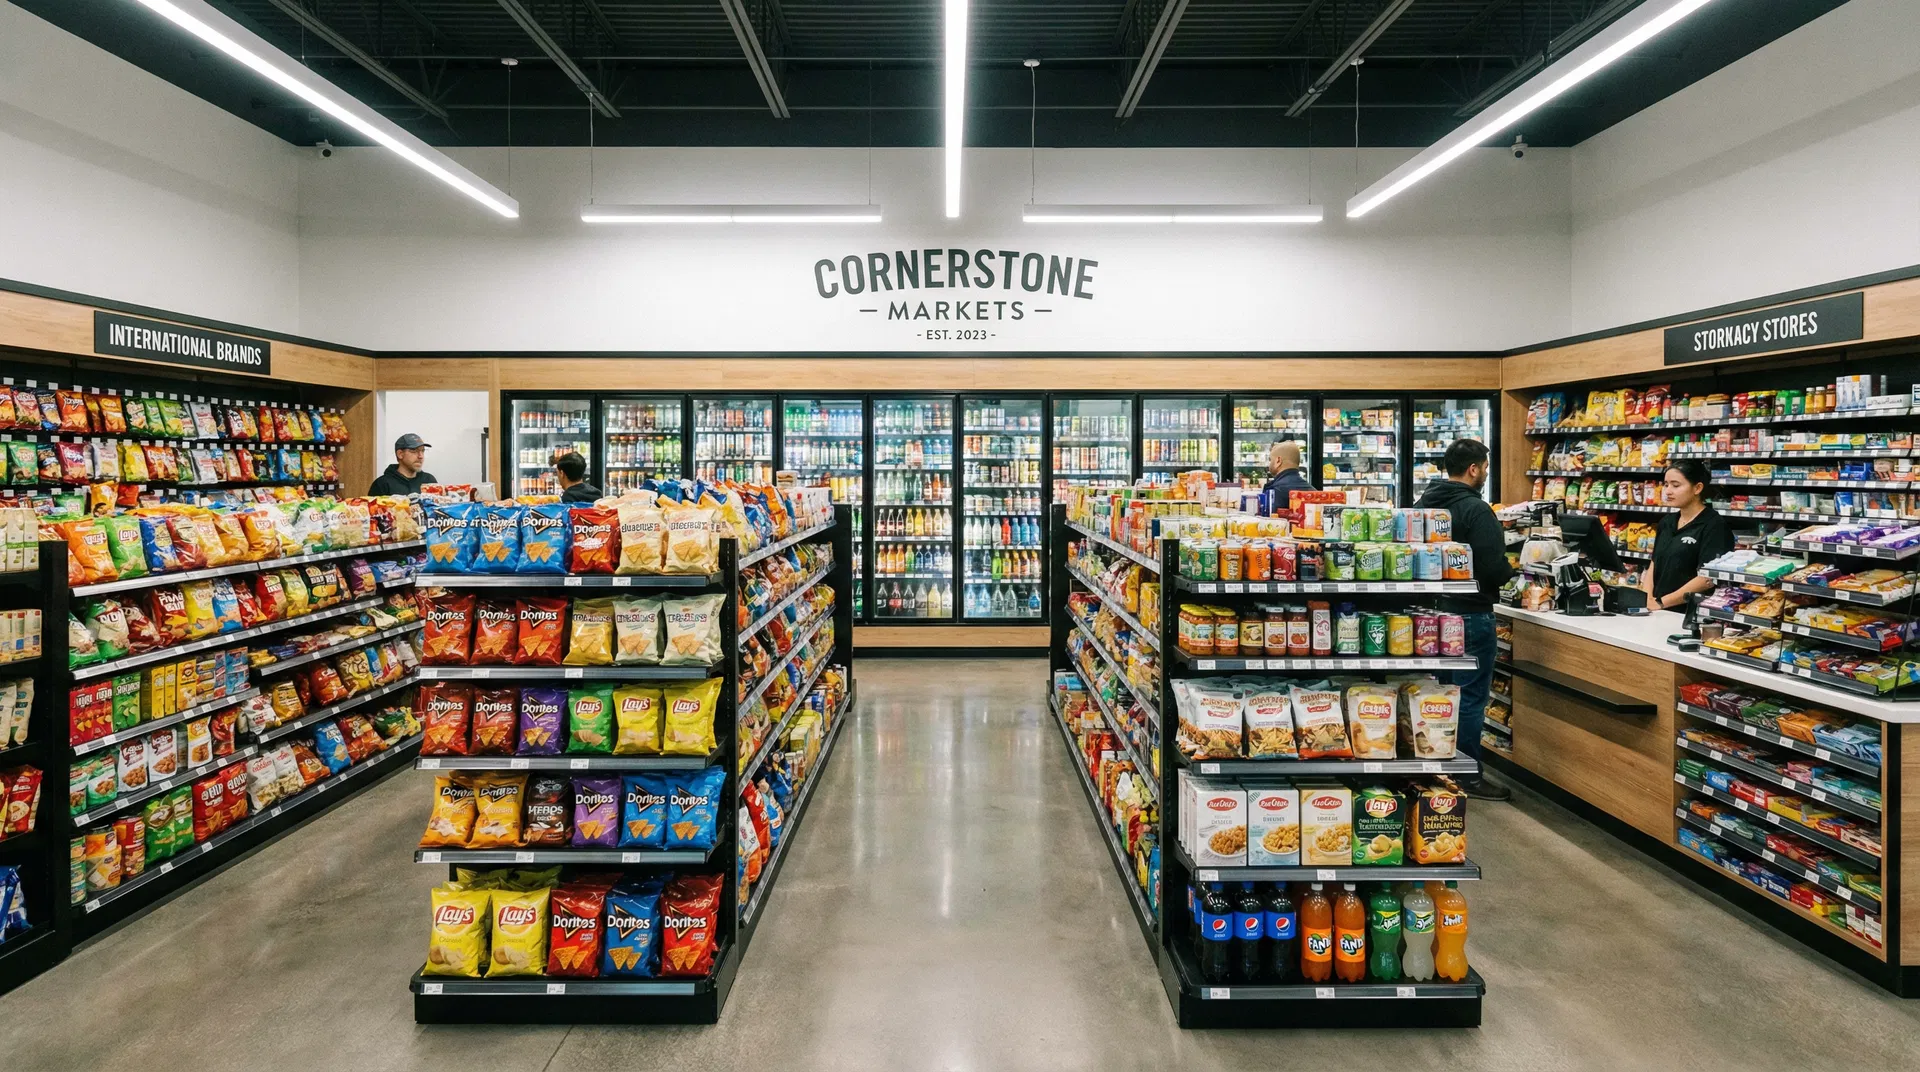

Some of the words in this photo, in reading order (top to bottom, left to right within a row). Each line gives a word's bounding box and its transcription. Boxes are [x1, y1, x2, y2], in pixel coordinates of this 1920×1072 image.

[814, 249, 1098, 300] CORNERSTONE
[888, 301, 1024, 320] MARKETS
[926, 329, 952, 340] EST.
[956, 329, 987, 340] 2023
[1694, 321, 1759, 352] STORKACY
[1762, 311, 1818, 342] STORES
[109, 323, 214, 360] INTERNATIONAL
[216, 341, 262, 366] BRANDS
[553, 914, 596, 929] Doritos
[607, 914, 650, 929] Doritos
[664, 915, 707, 929] Doritos
